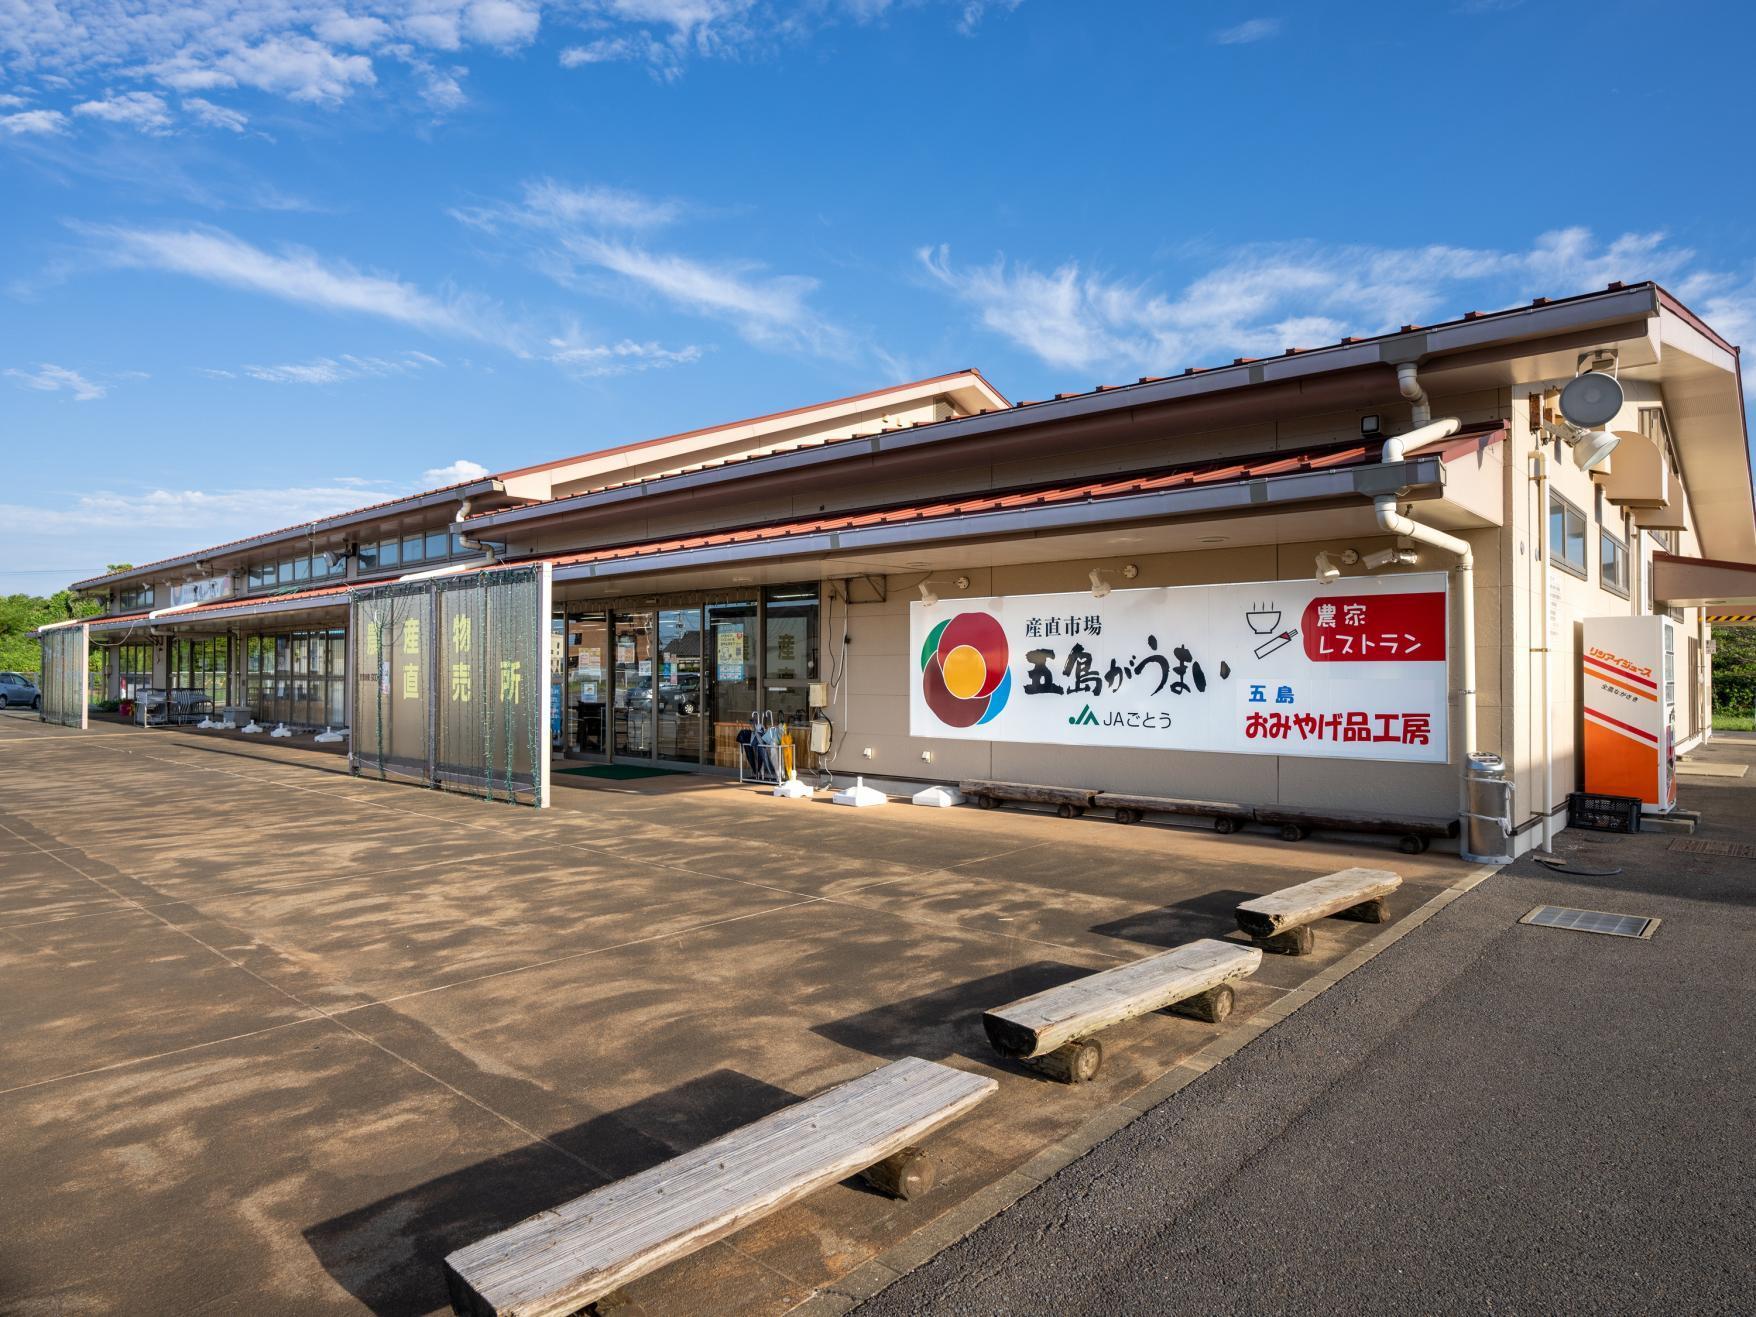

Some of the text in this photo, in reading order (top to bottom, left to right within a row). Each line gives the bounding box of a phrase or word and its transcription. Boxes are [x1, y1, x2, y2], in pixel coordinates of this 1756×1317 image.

[1025, 615, 1102, 637] 産直市場
[1317, 603, 1367, 628] 農家
[1319, 633, 1421, 654] レストラン
[1023, 634, 1231, 697] 五島がうまい
[1248, 684, 1295, 704] 五島
[1103, 711, 1172, 729] JAごとう
[1245, 711, 1431, 745] おみやげ品工房
